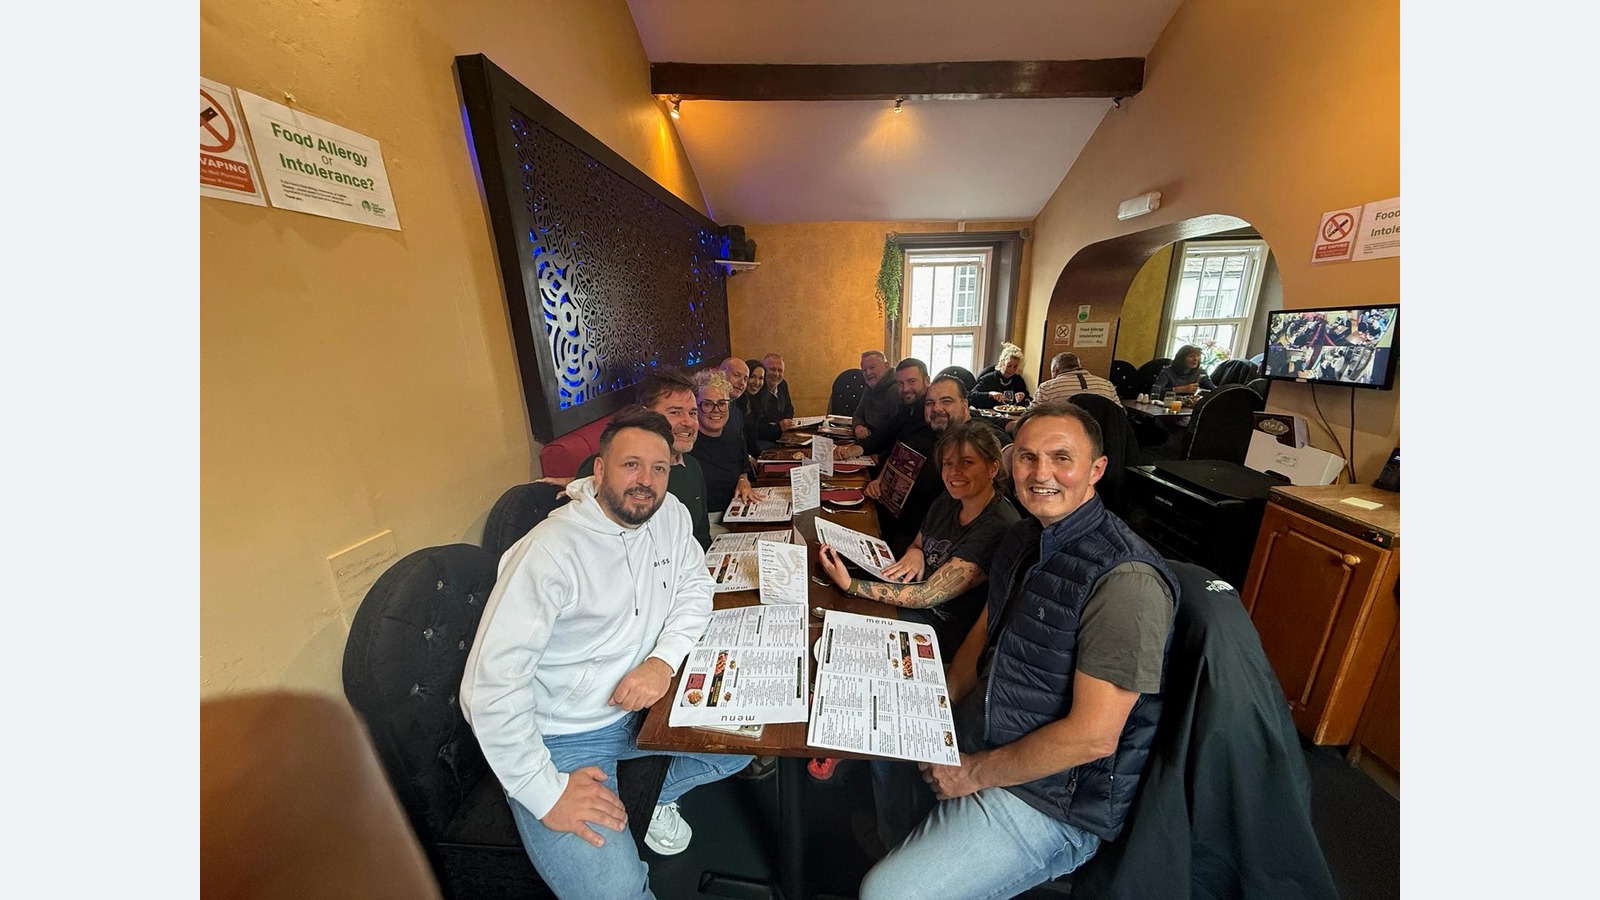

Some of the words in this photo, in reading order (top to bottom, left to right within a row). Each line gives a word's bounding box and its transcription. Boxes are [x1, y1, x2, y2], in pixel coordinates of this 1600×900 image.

[270, 121, 314, 149] Food
[317, 137, 368, 168] Allergy
[200, 157, 247, 174] VAPING
[321, 155, 334, 166] or
[279, 152, 374, 191] Intolerance?
[866, 618, 894, 626] menu
